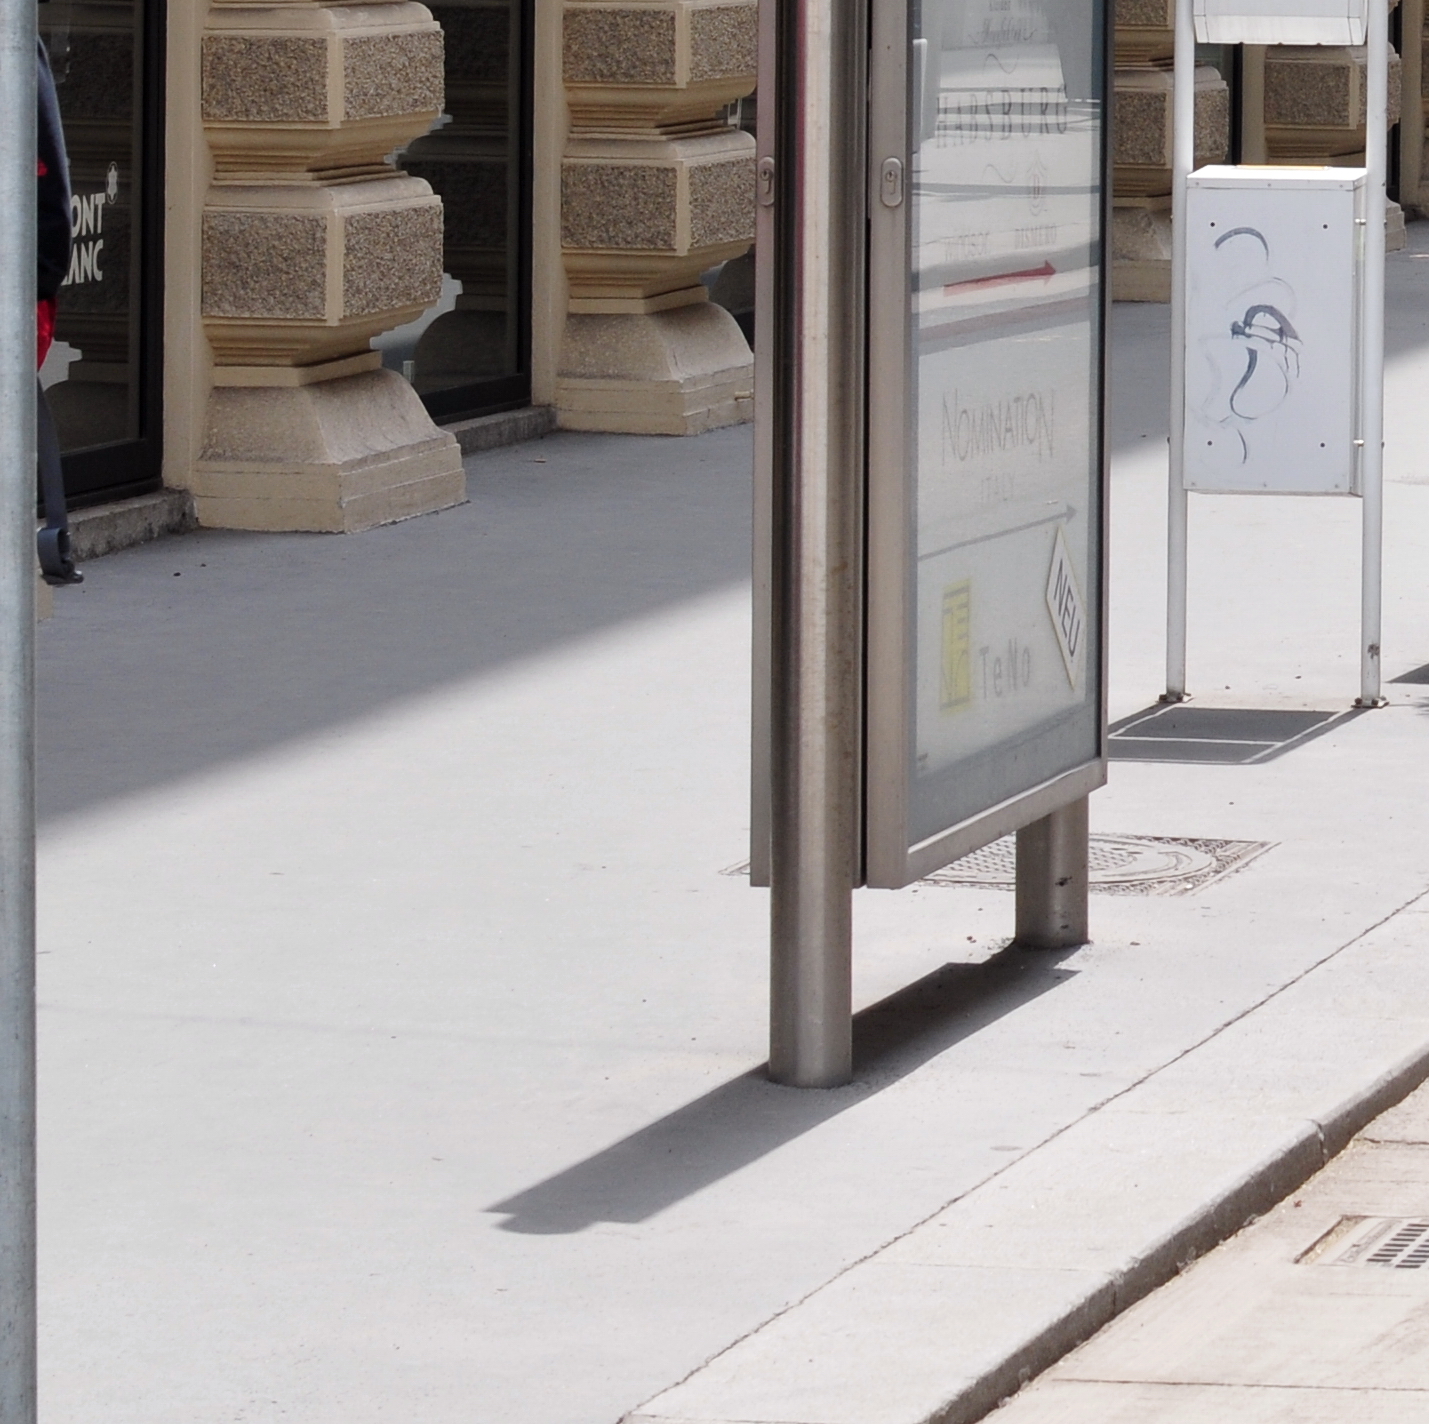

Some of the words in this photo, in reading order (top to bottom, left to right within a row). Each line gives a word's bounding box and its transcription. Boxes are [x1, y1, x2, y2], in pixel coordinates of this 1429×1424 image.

[936, 83, 1068, 149] HABSBURG
[71, 193, 106, 238] ONT
[61, 239, 104, 286] ANC
[942, 387, 1055, 467] NOMINATION
[1053, 558, 1081, 658] NEU
[979, 637, 1031, 702] TeNo
